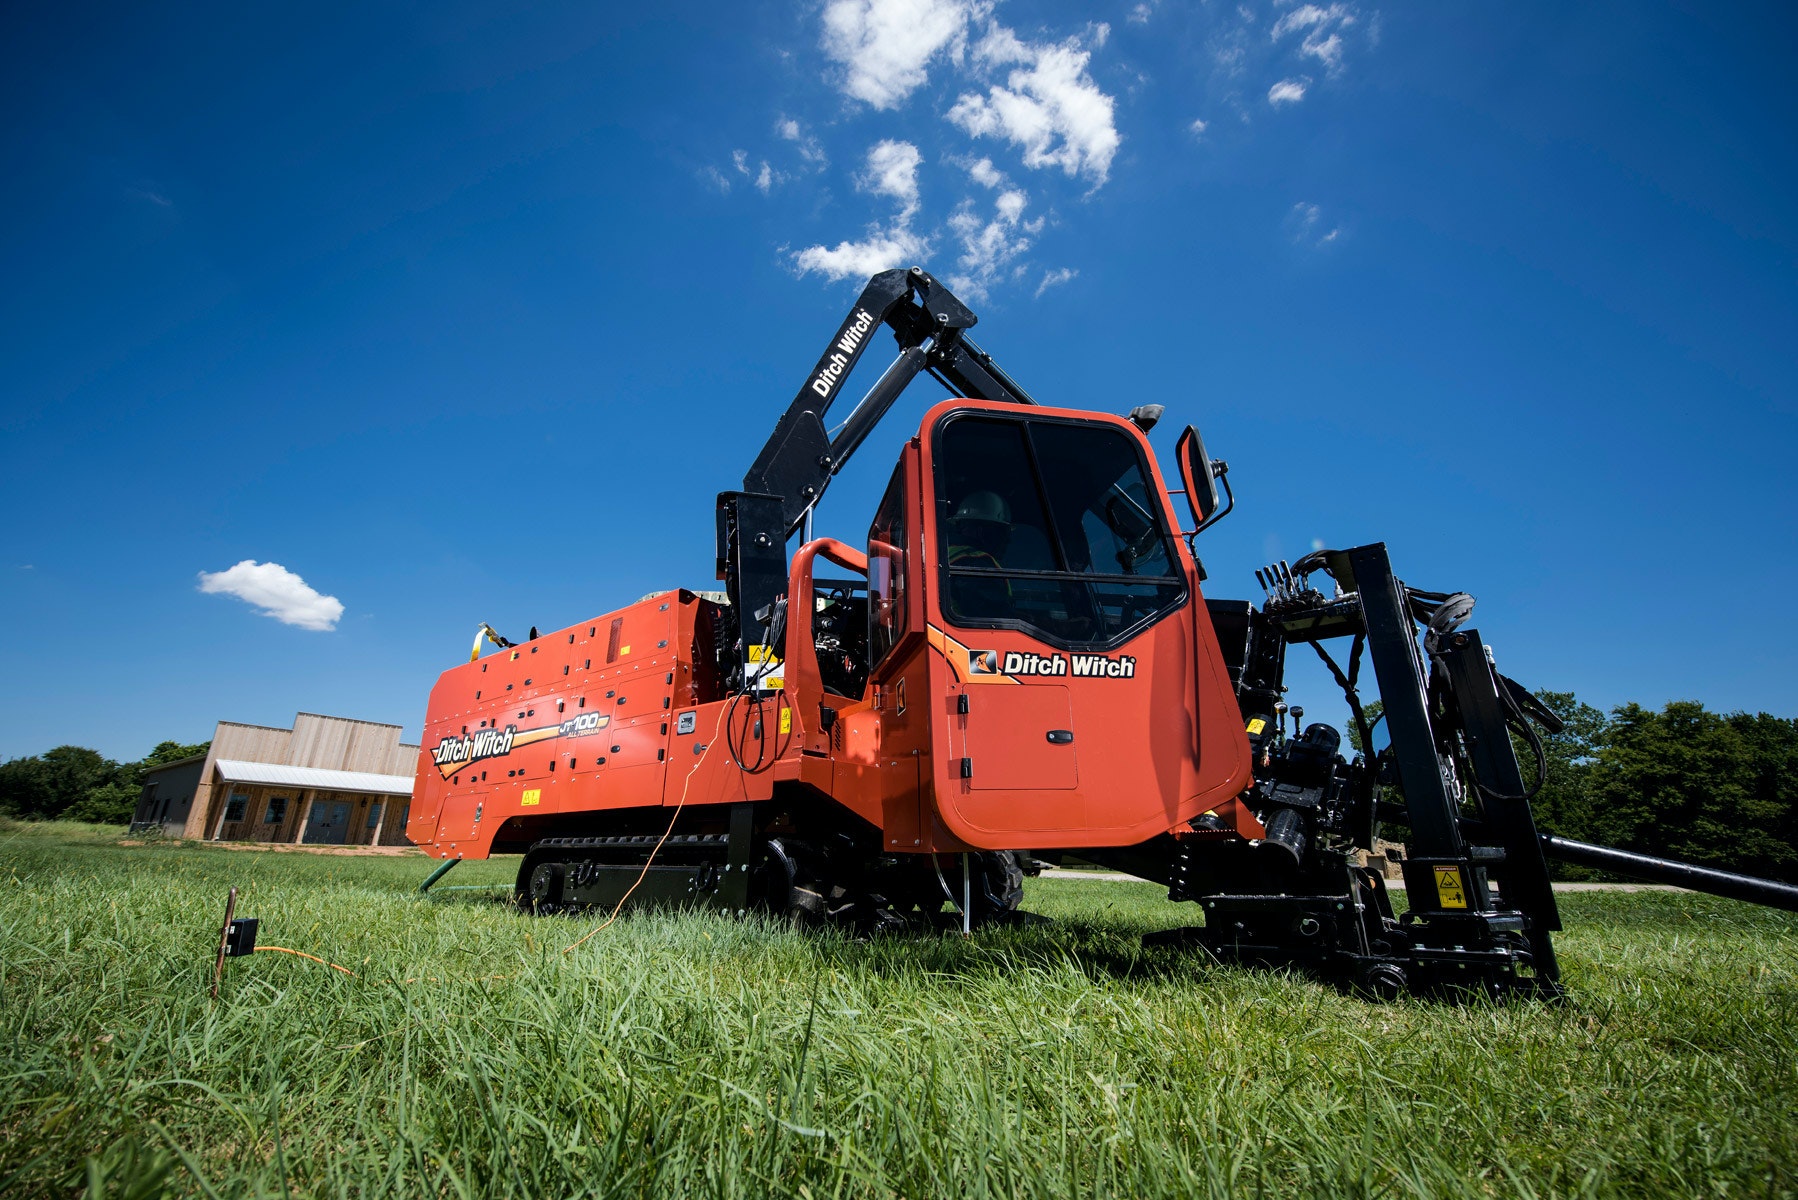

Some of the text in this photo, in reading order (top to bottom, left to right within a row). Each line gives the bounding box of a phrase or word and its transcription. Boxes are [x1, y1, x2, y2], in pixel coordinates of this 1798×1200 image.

[812, 310, 873, 397] Ditch Witch
[1004, 653, 1134, 677] Ditch Witch
[436, 728, 513, 763] Ditch Witch
